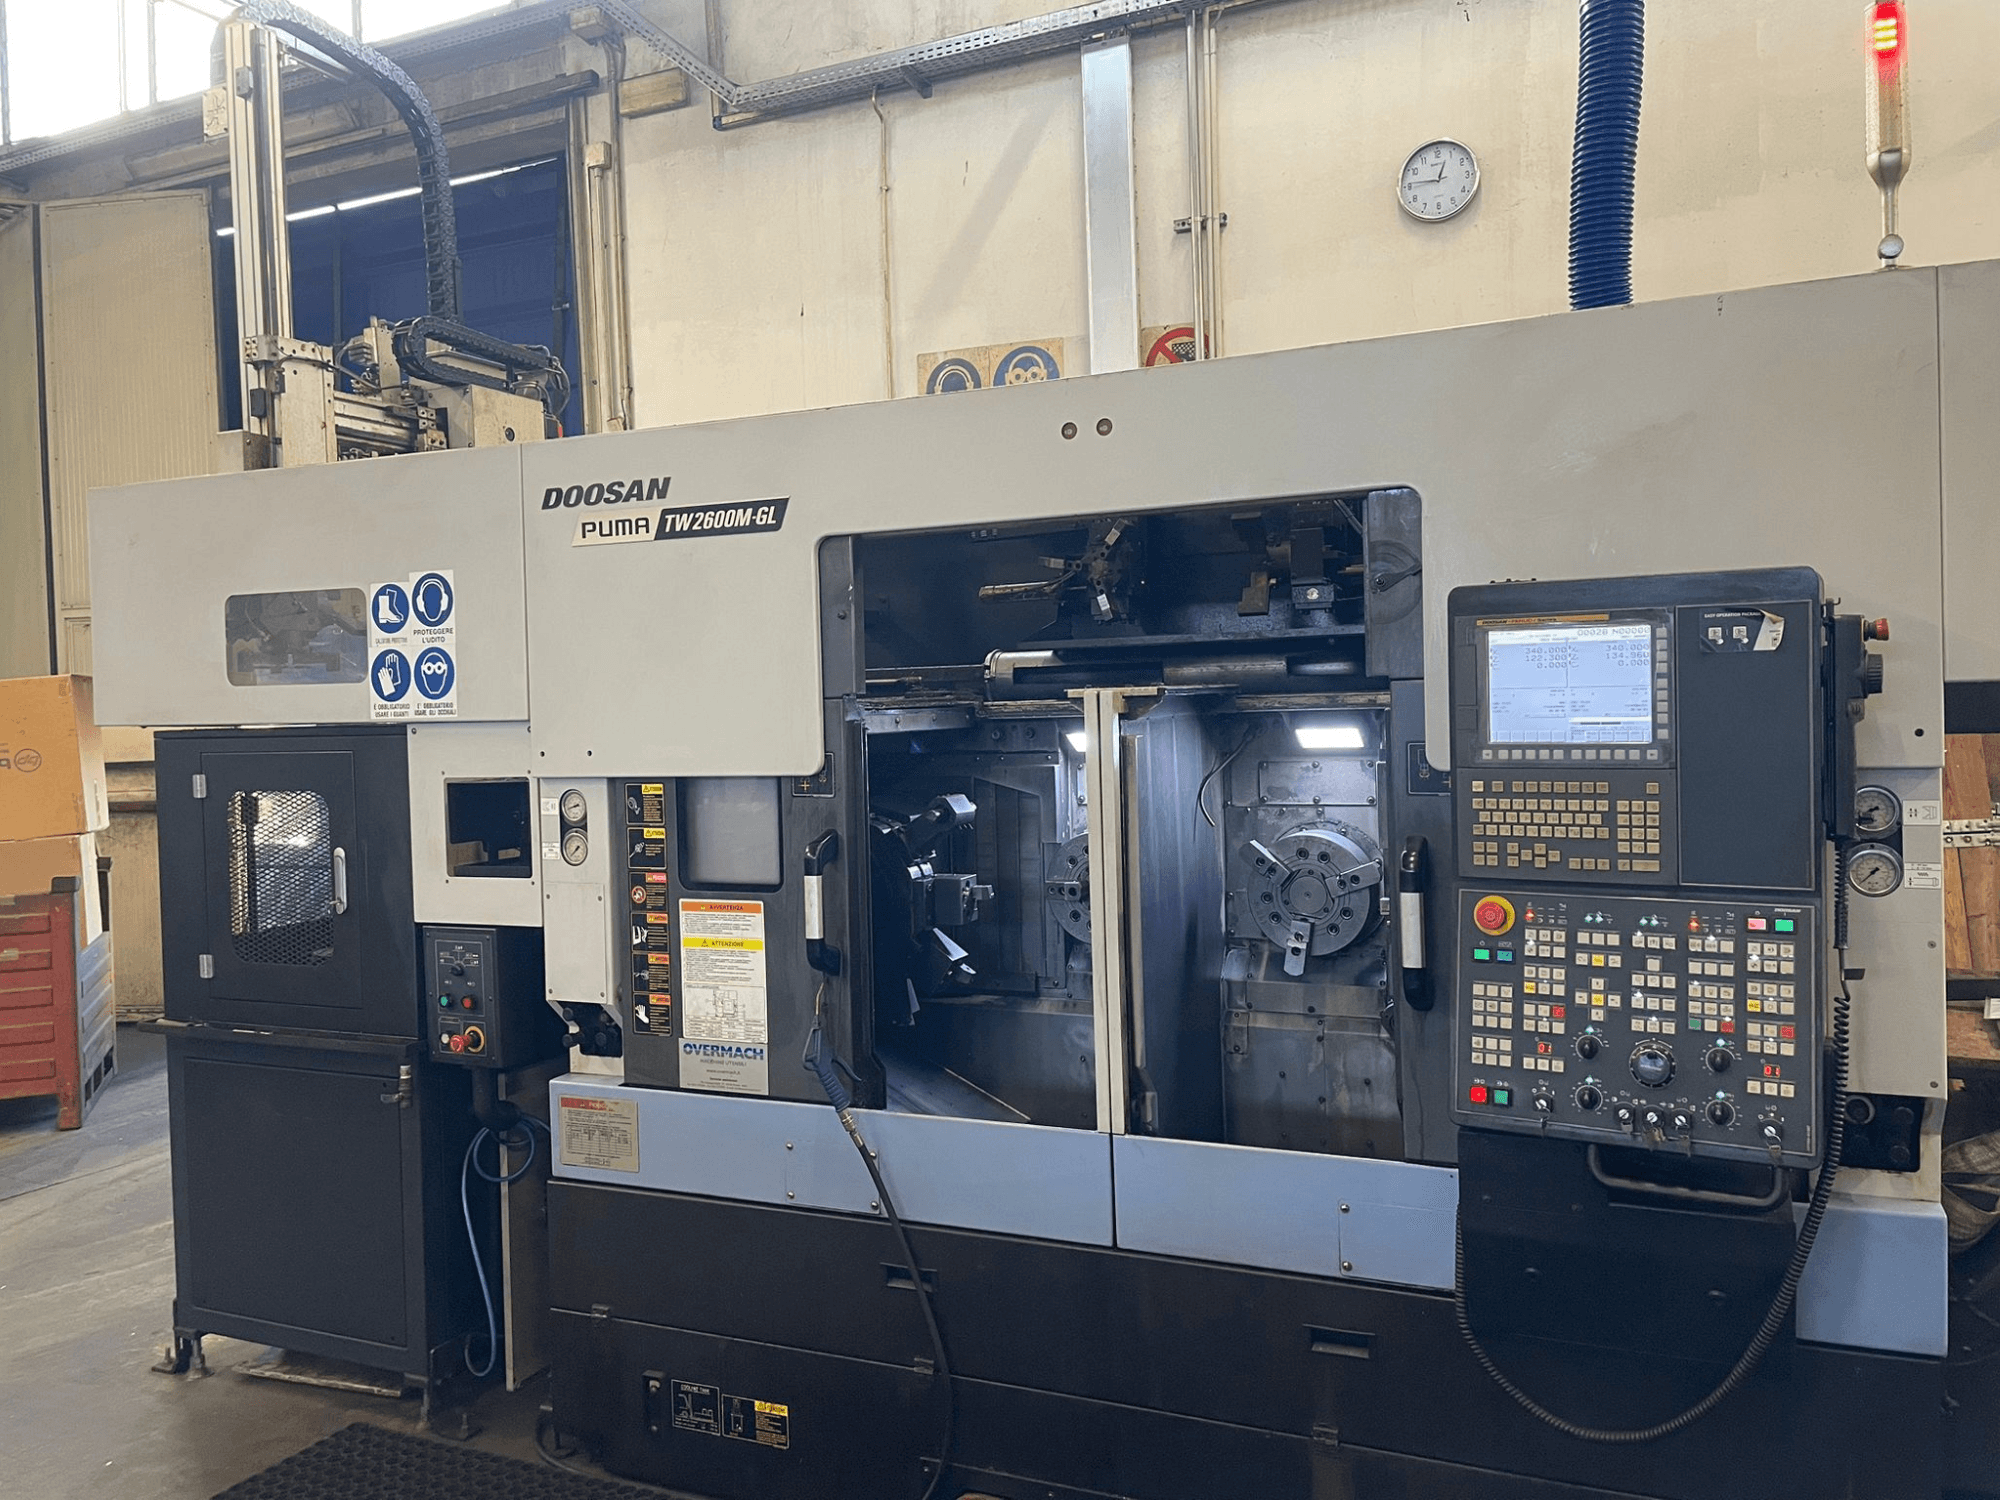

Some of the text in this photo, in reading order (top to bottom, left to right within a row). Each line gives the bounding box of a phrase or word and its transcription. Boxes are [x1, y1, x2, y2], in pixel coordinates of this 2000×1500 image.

[1434, 149, 1441, 158] 12
[1420, 157, 1427, 165] 11
[1459, 157, 1465, 166] 2
[1411, 167, 1419, 176] 10
[1464, 170, 1470, 179] 3
[1460, 185, 1466, 193] 4
[1412, 194, 1418, 202] 8
[1450, 196, 1456, 205] 5
[1422, 202, 1428, 210] 7
[1436, 201, 1442, 210] 6
[541, 476, 671, 511] DOOSAN
[581, 505, 777, 539] PUMA TW2600M-GL
[683, 1043, 764, 1061] OVERMACH
